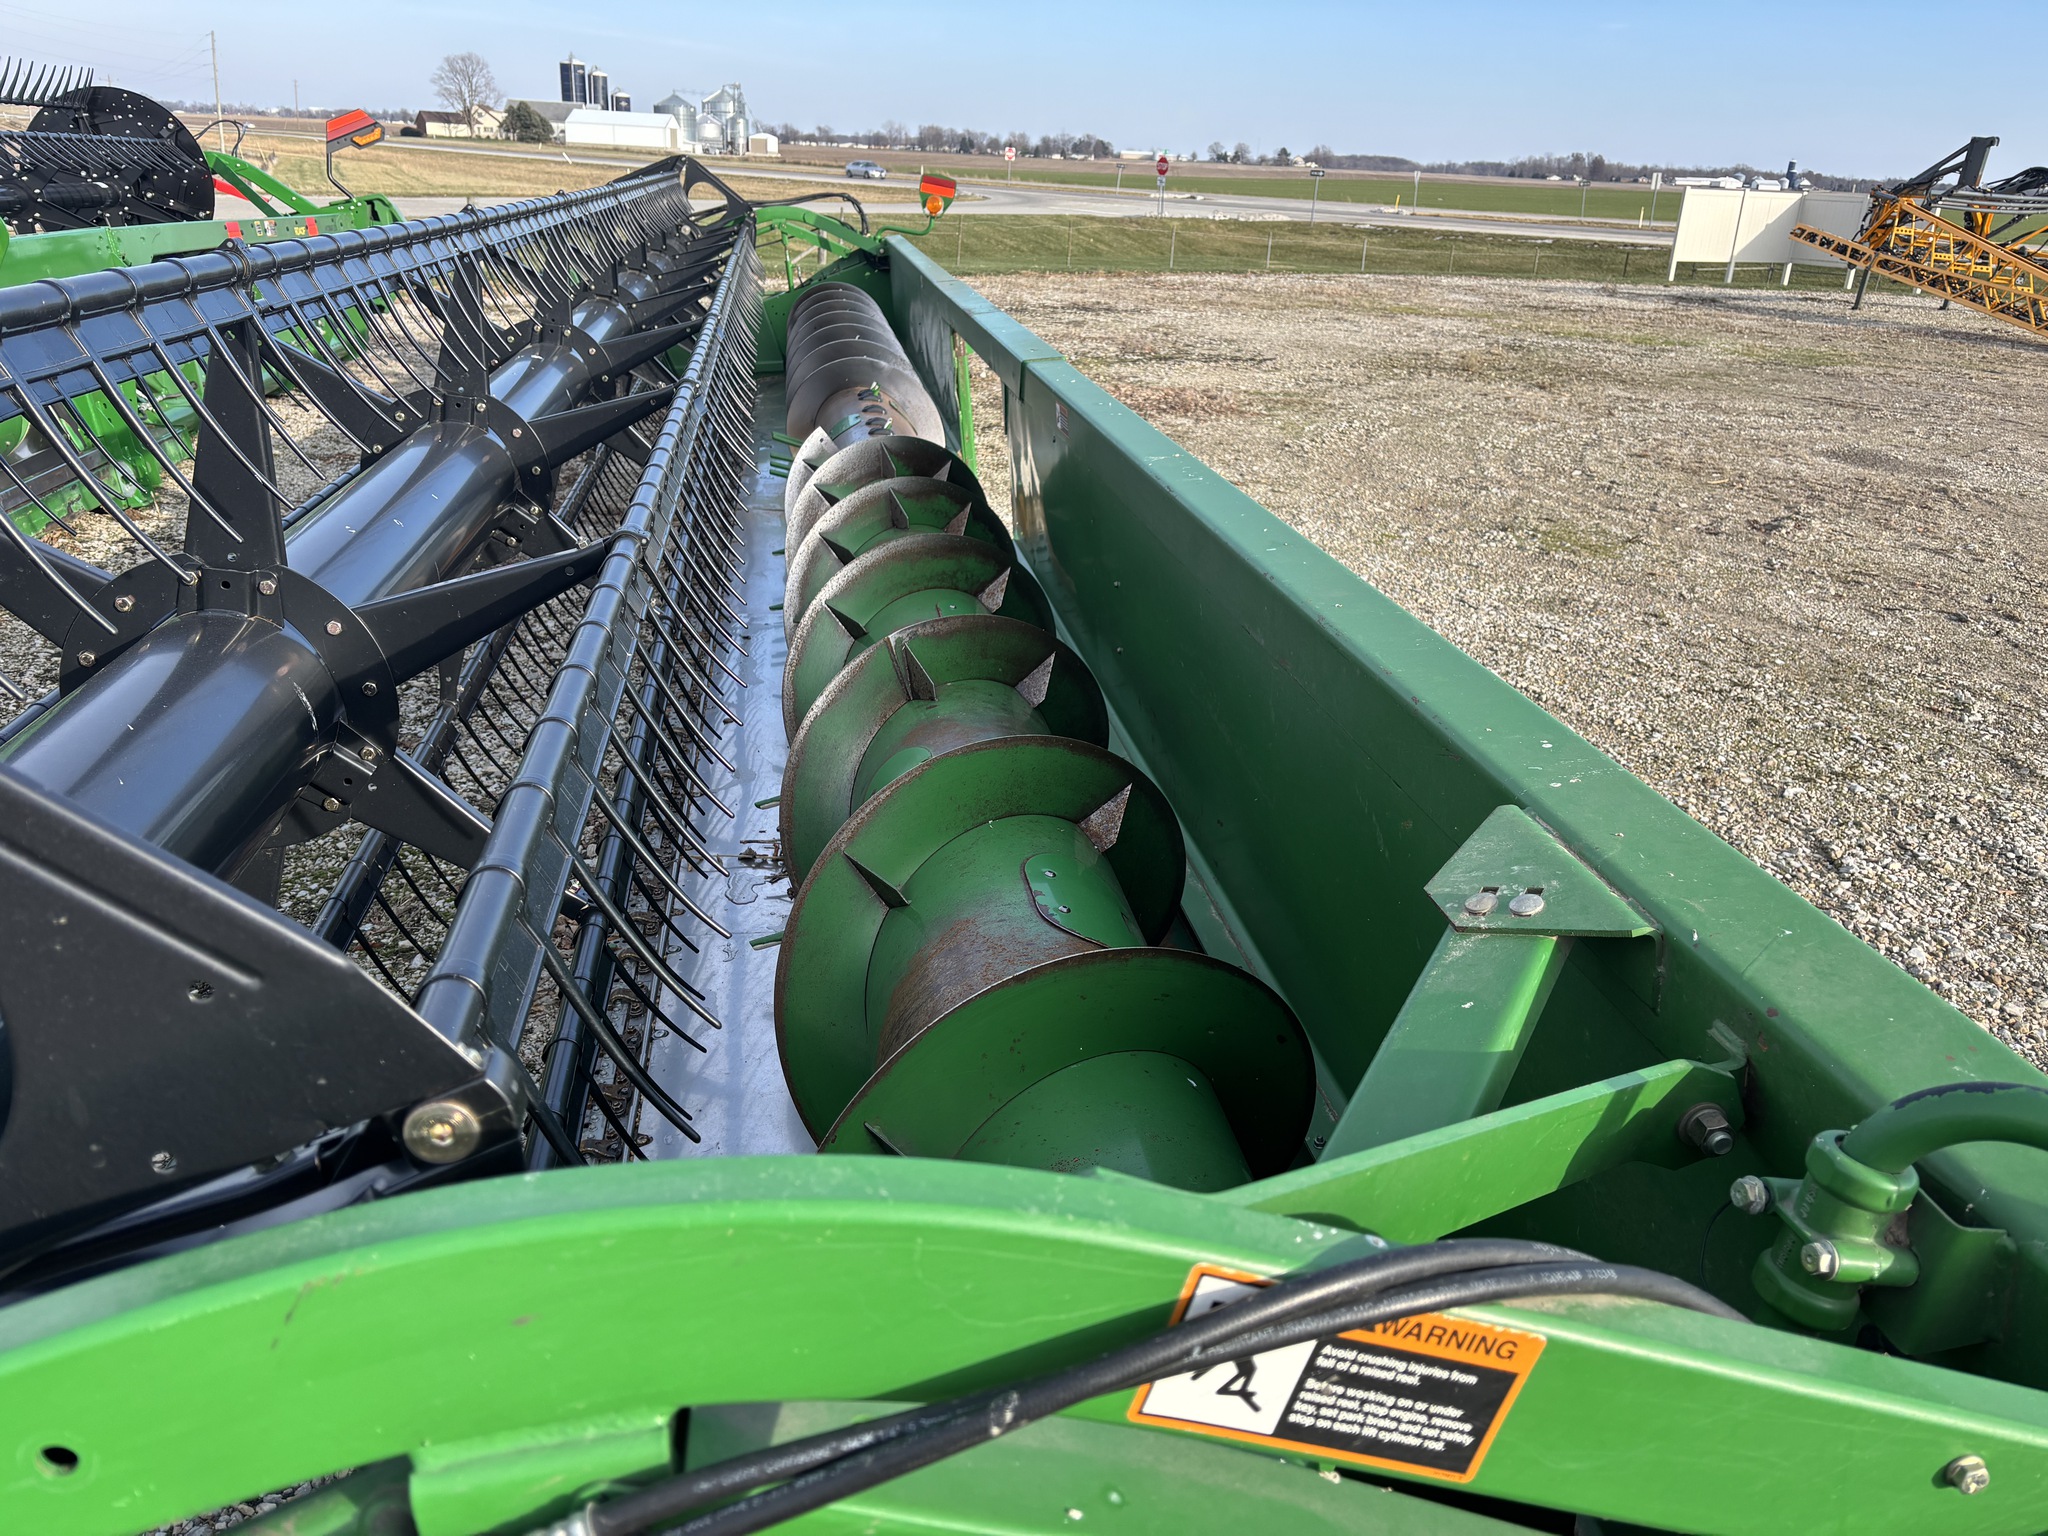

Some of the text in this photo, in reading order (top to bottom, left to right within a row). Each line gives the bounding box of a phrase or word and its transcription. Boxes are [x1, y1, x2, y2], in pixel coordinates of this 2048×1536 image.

[1380, 1317, 1519, 1361] WARNING
[1315, 1355, 1421, 1387] fall of a raised reel.
[1320, 1344, 1479, 1386] Avoid crushing injuries from
[1299, 1390, 1474, 1433] raised reel, stop engine, remove
[1304, 1377, 1465, 1419] Befre working on or under
[1288, 1412, 1446, 1451] stop on each lift cylinder rod.
[1293, 1400, 1475, 1448] key, set park brake and set safety
